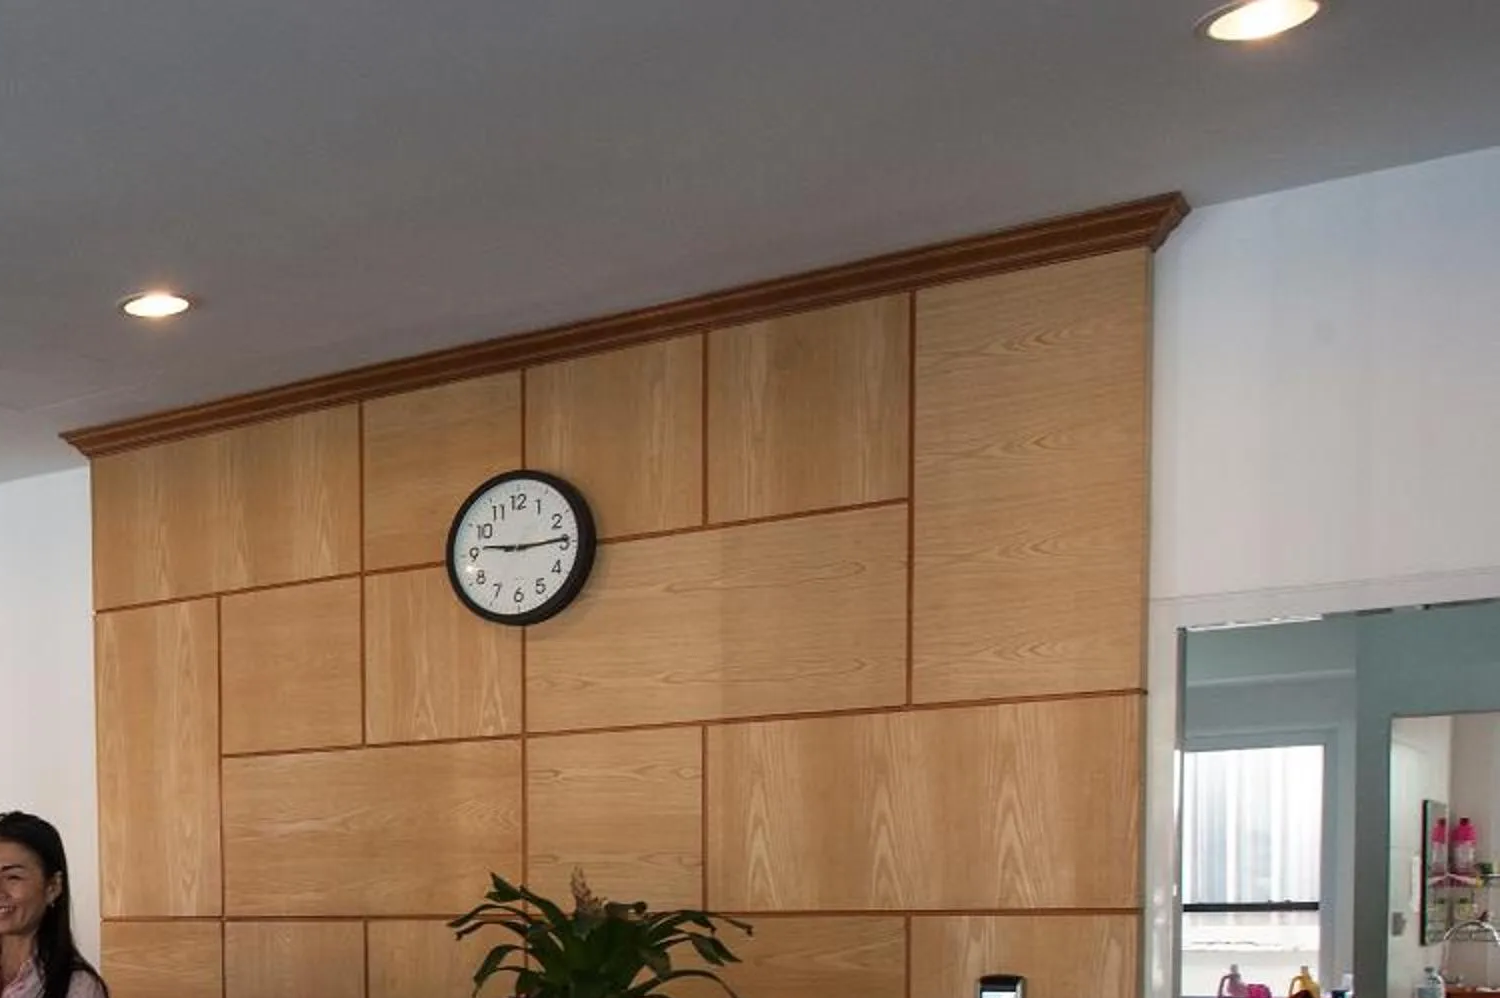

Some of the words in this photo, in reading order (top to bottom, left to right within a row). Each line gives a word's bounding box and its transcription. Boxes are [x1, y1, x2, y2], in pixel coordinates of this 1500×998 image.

[509, 494, 527, 510] 12
[535, 499, 541, 514] 1
[492, 504, 505, 520] 11
[552, 514, 562, 529] 2
[477, 523, 493, 539] 10
[559, 534, 570, 550] 3
[469, 547, 479, 562] 9
[551, 559, 561, 573] 4
[476, 570, 486, 584] 8
[493, 584, 502, 598] 7
[535, 578, 546, 594] 5
[514, 588, 524, 602] 6
